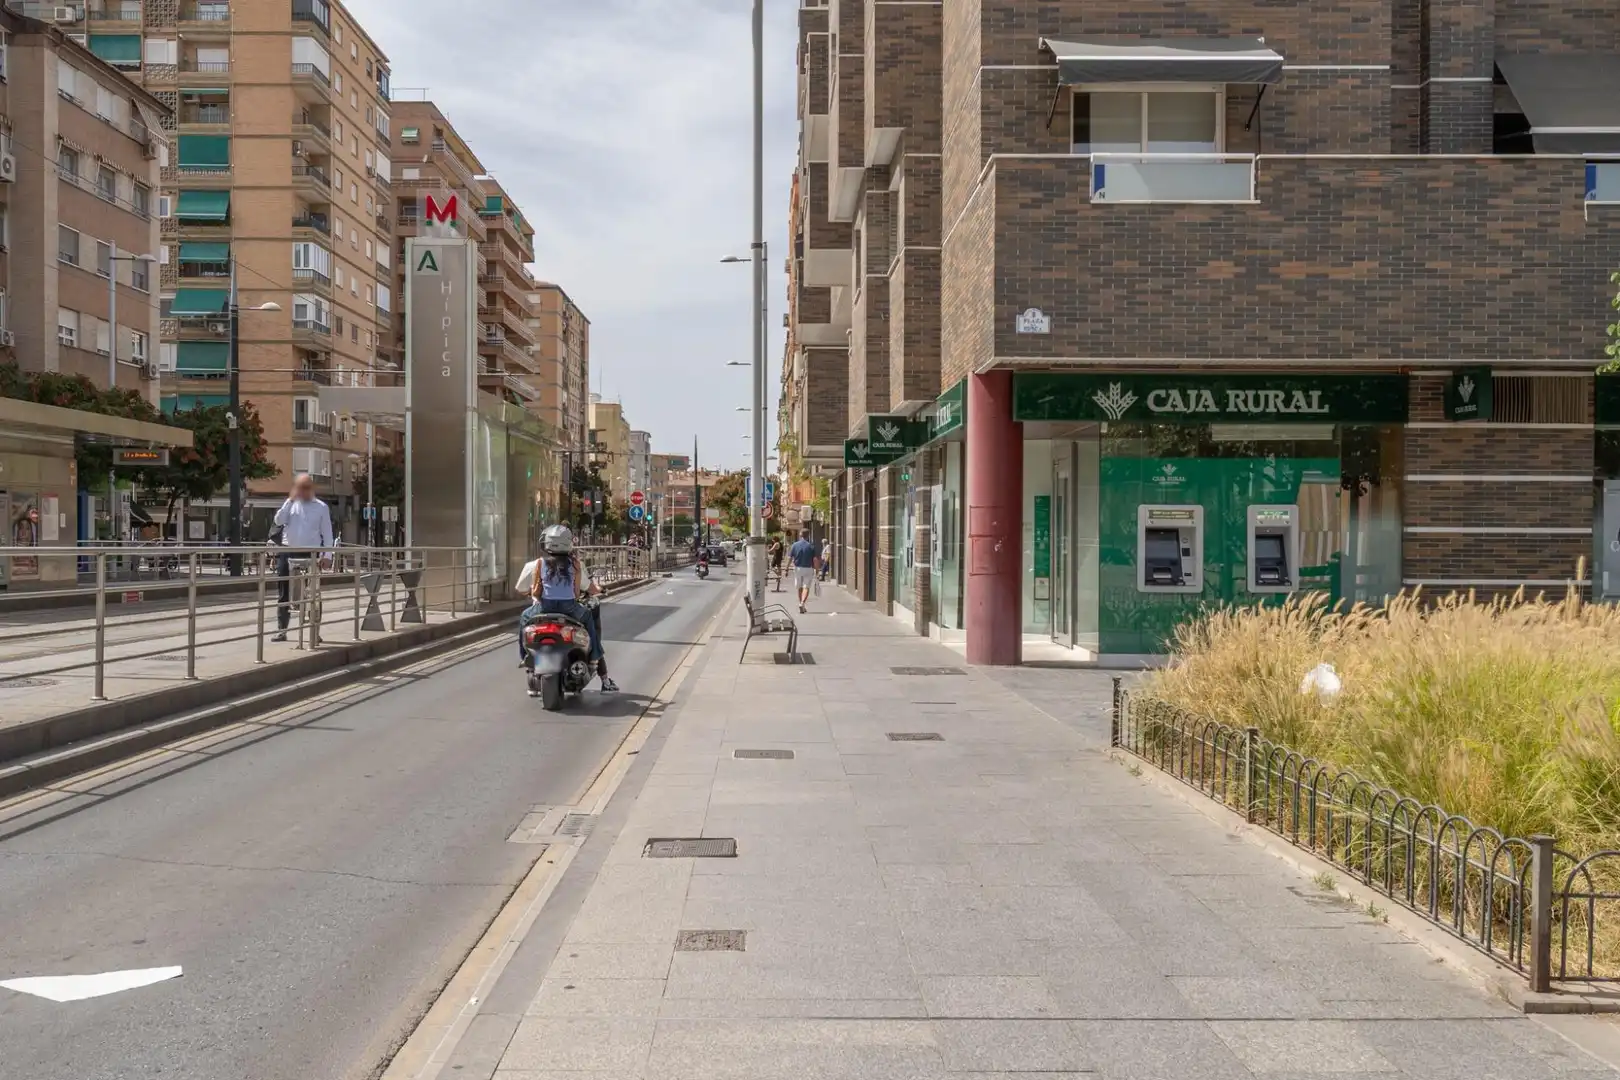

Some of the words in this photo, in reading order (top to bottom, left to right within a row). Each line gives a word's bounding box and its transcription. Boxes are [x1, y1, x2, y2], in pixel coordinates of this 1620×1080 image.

[441, 281, 452, 377] Hípica
[1147, 389, 1220, 413] CAJA
[1226, 389, 1330, 413] RURAL
